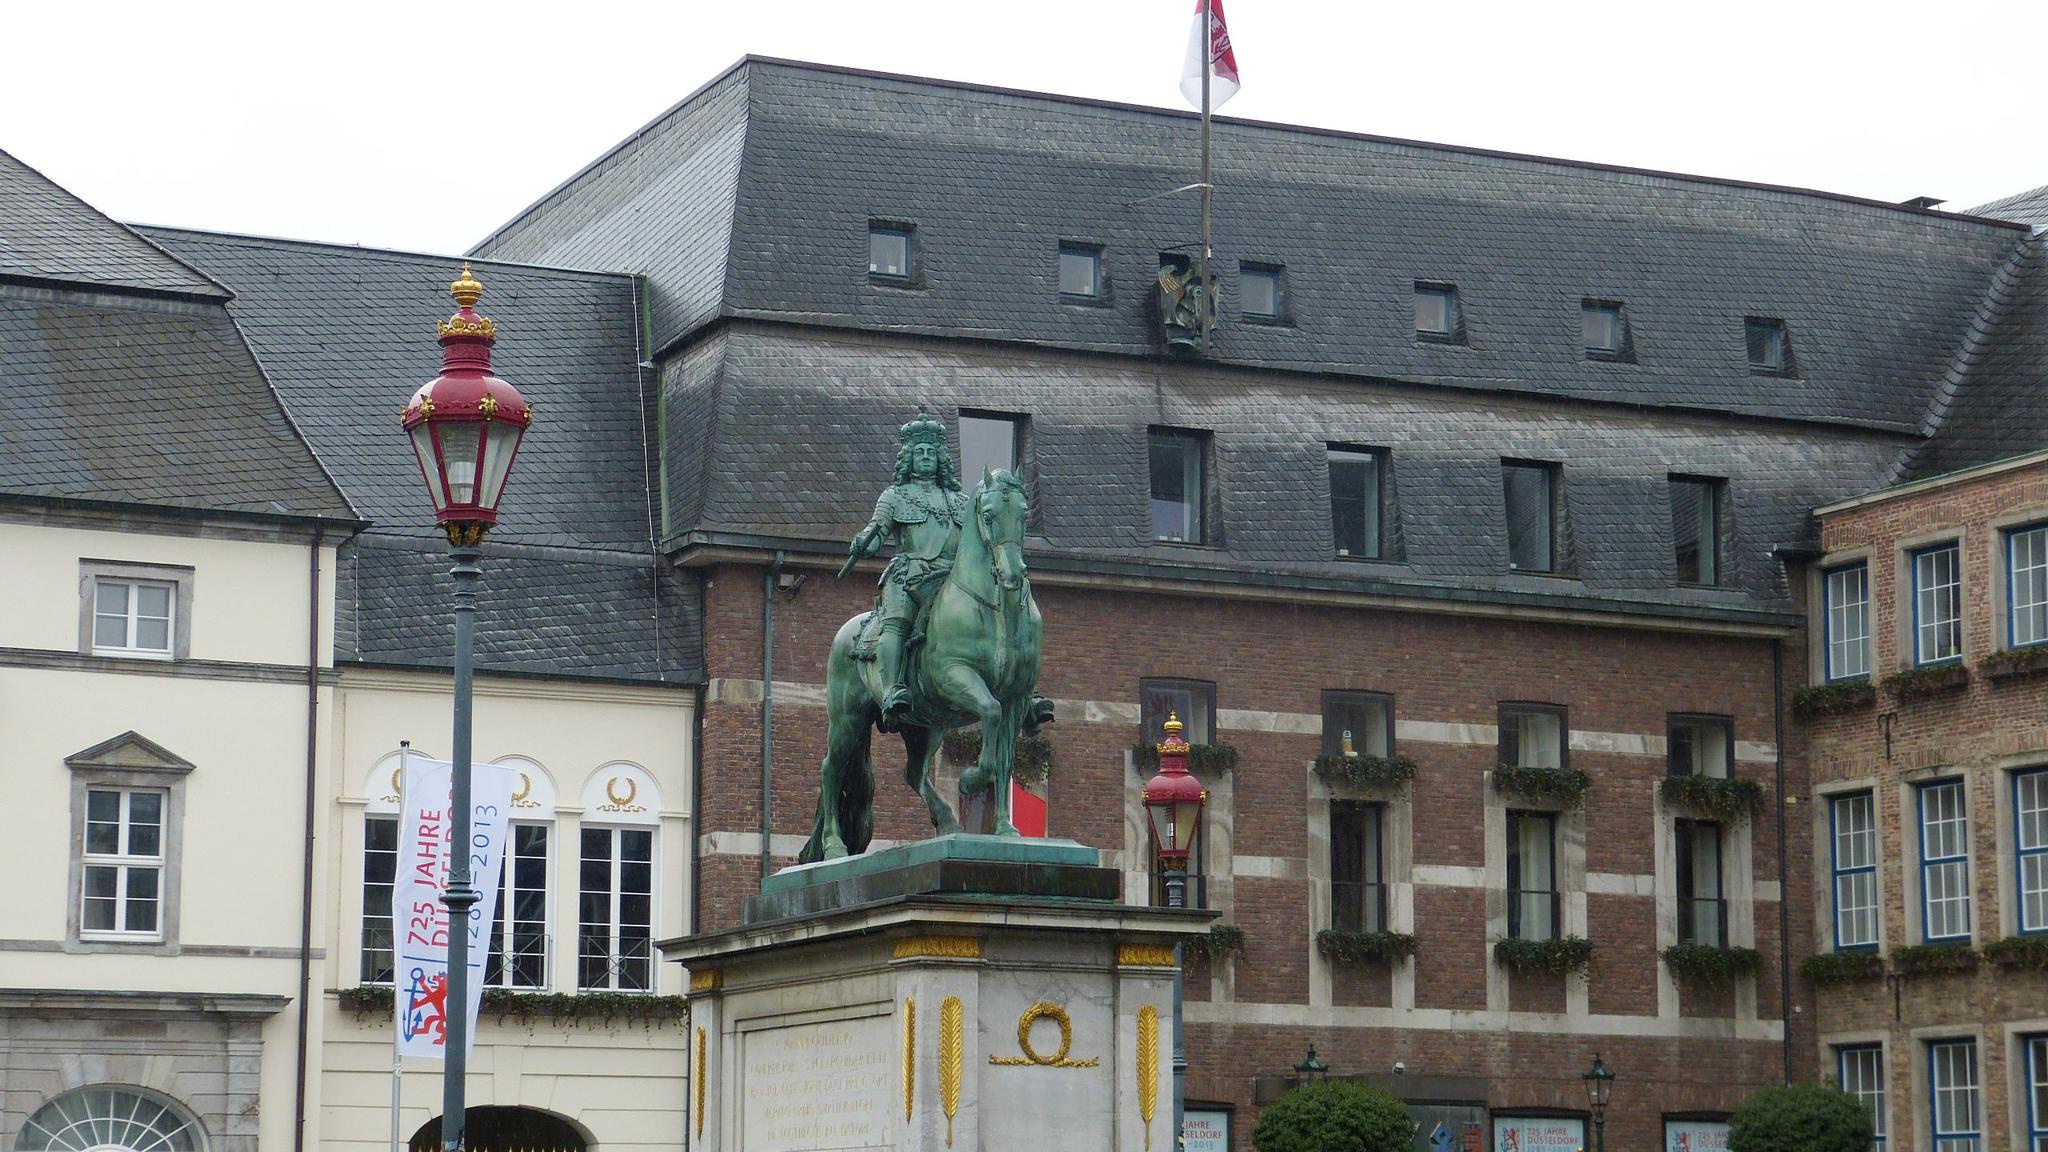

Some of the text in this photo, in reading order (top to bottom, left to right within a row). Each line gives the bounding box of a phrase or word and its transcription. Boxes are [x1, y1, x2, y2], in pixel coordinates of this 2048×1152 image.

[407, 809, 441, 946] 725 JAHRE
[1544, 1127, 1567, 1136] JAHRE
